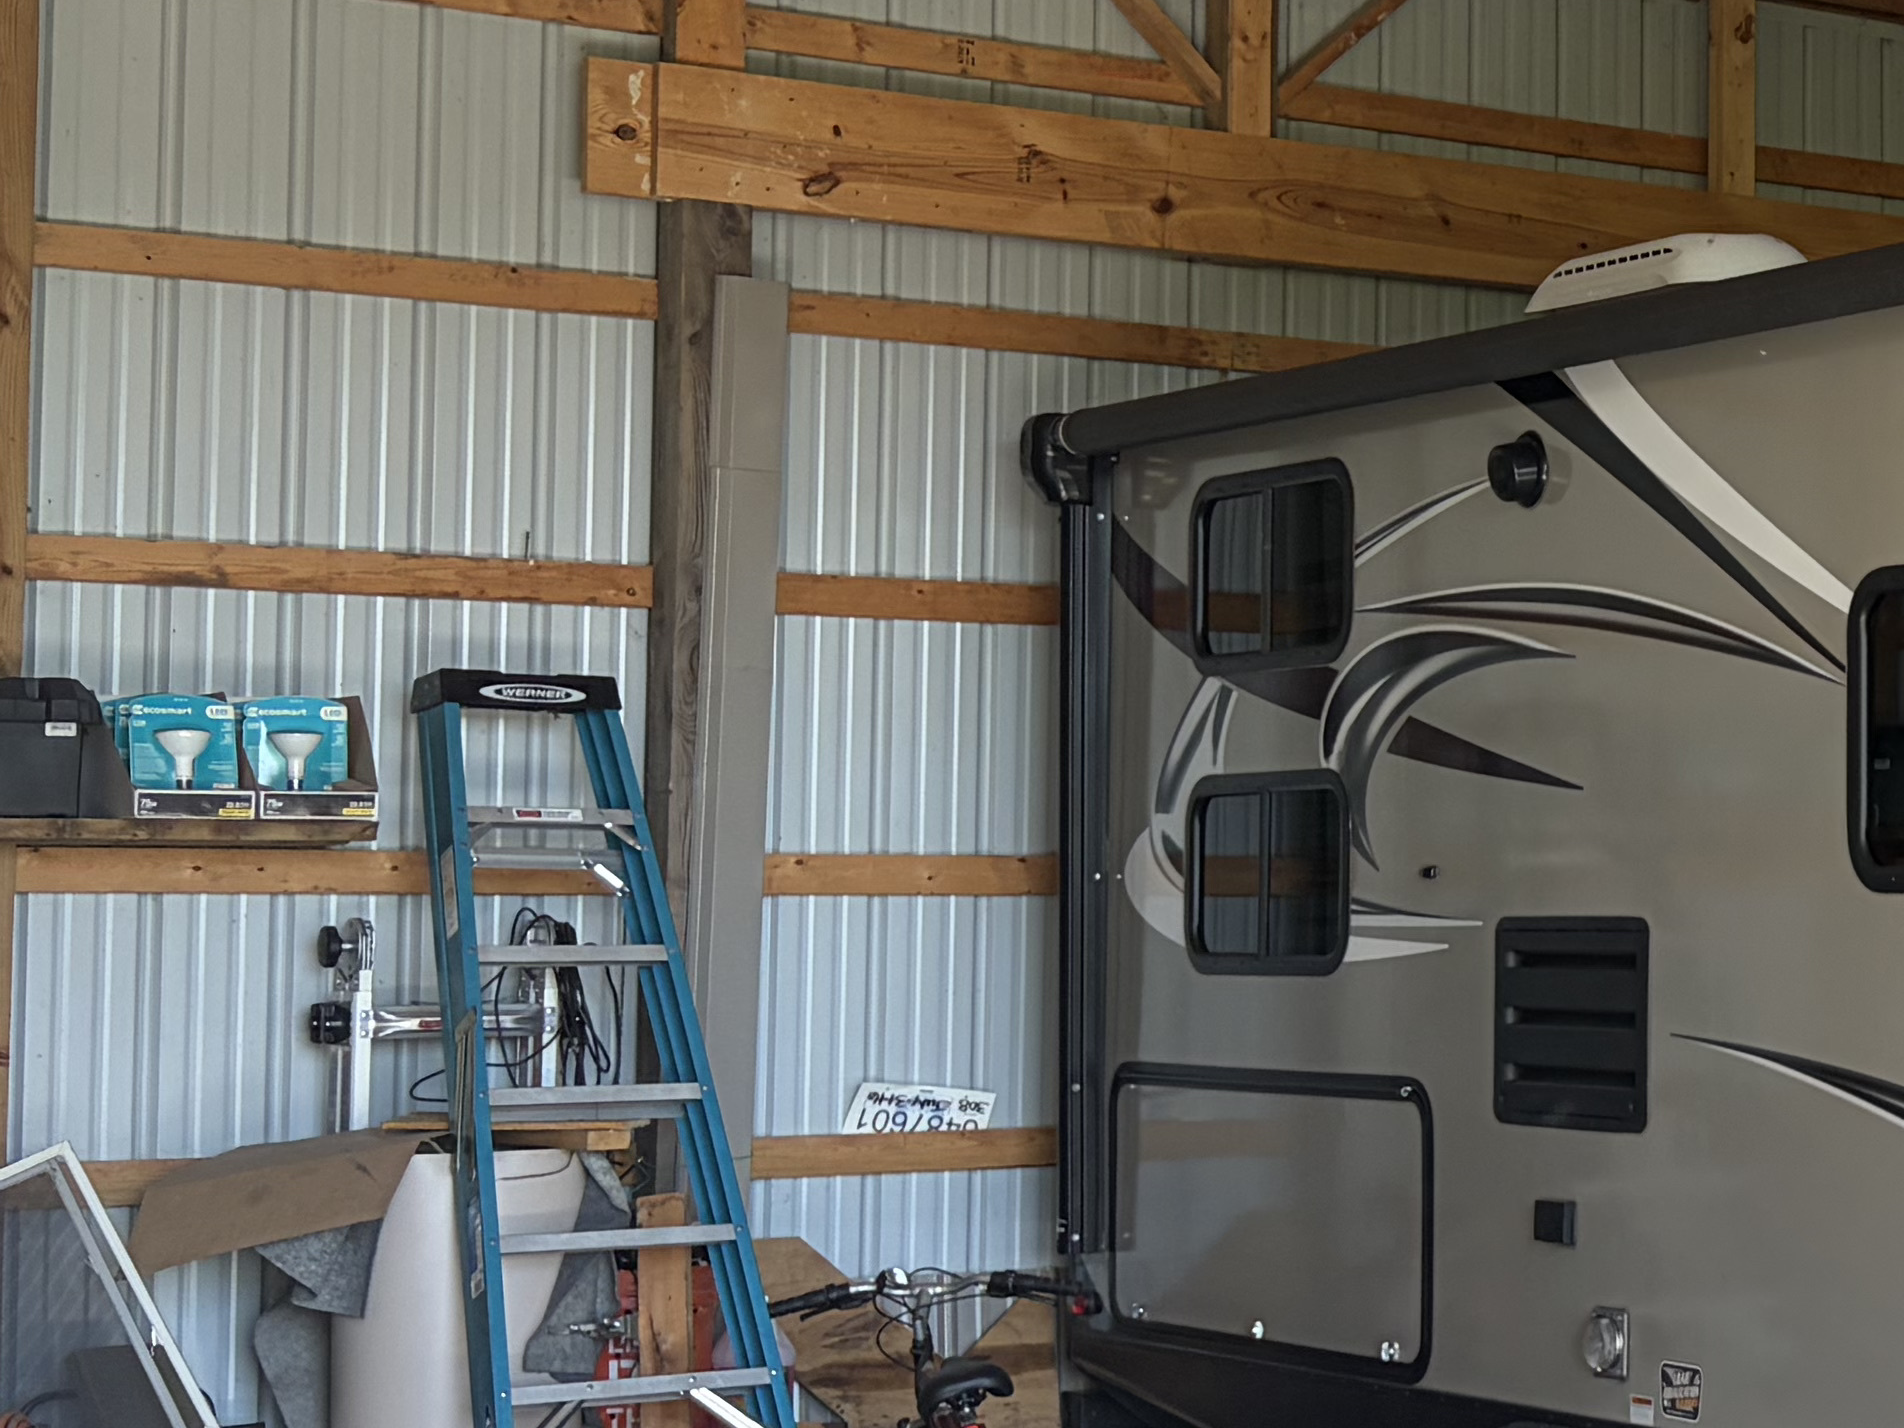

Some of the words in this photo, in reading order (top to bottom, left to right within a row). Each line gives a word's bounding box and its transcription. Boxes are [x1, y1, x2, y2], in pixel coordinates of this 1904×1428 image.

[501, 687, 567, 699] WERNER
[143, 707, 192, 715] ecosmart
[258, 708, 307, 716] ecosmart
